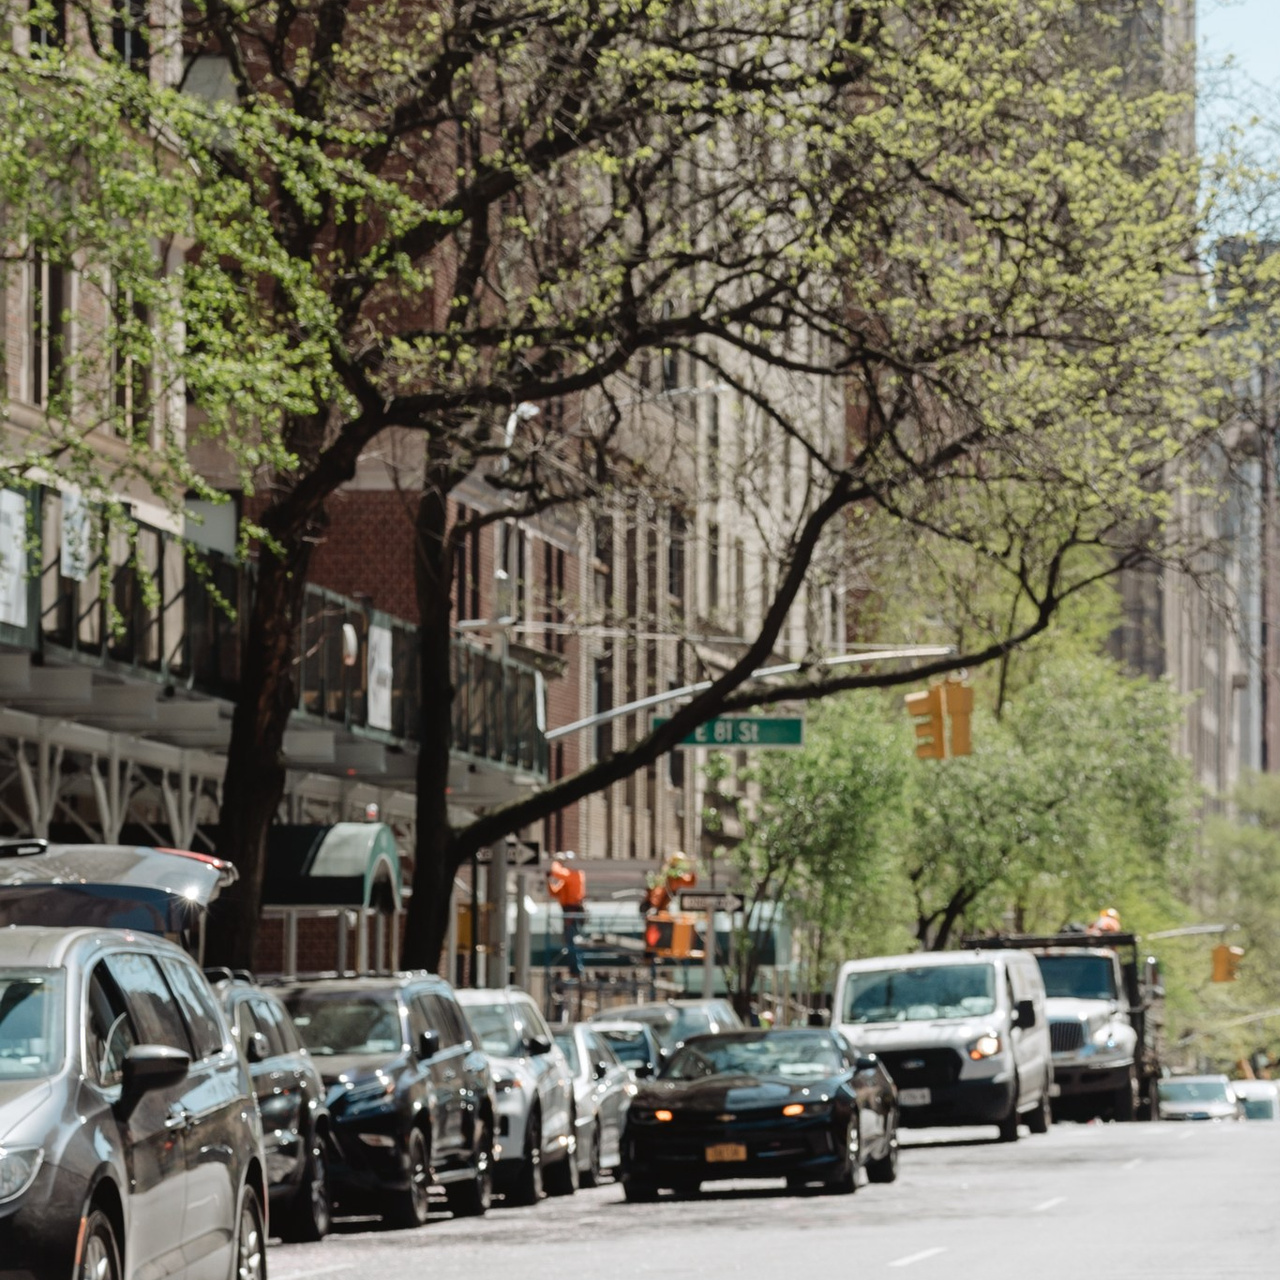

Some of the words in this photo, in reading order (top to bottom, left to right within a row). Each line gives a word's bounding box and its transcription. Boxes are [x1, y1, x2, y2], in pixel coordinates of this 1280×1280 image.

[694, 722, 707, 742] E
[714, 721, 733, 742] 81
[738, 721, 760, 742] St
